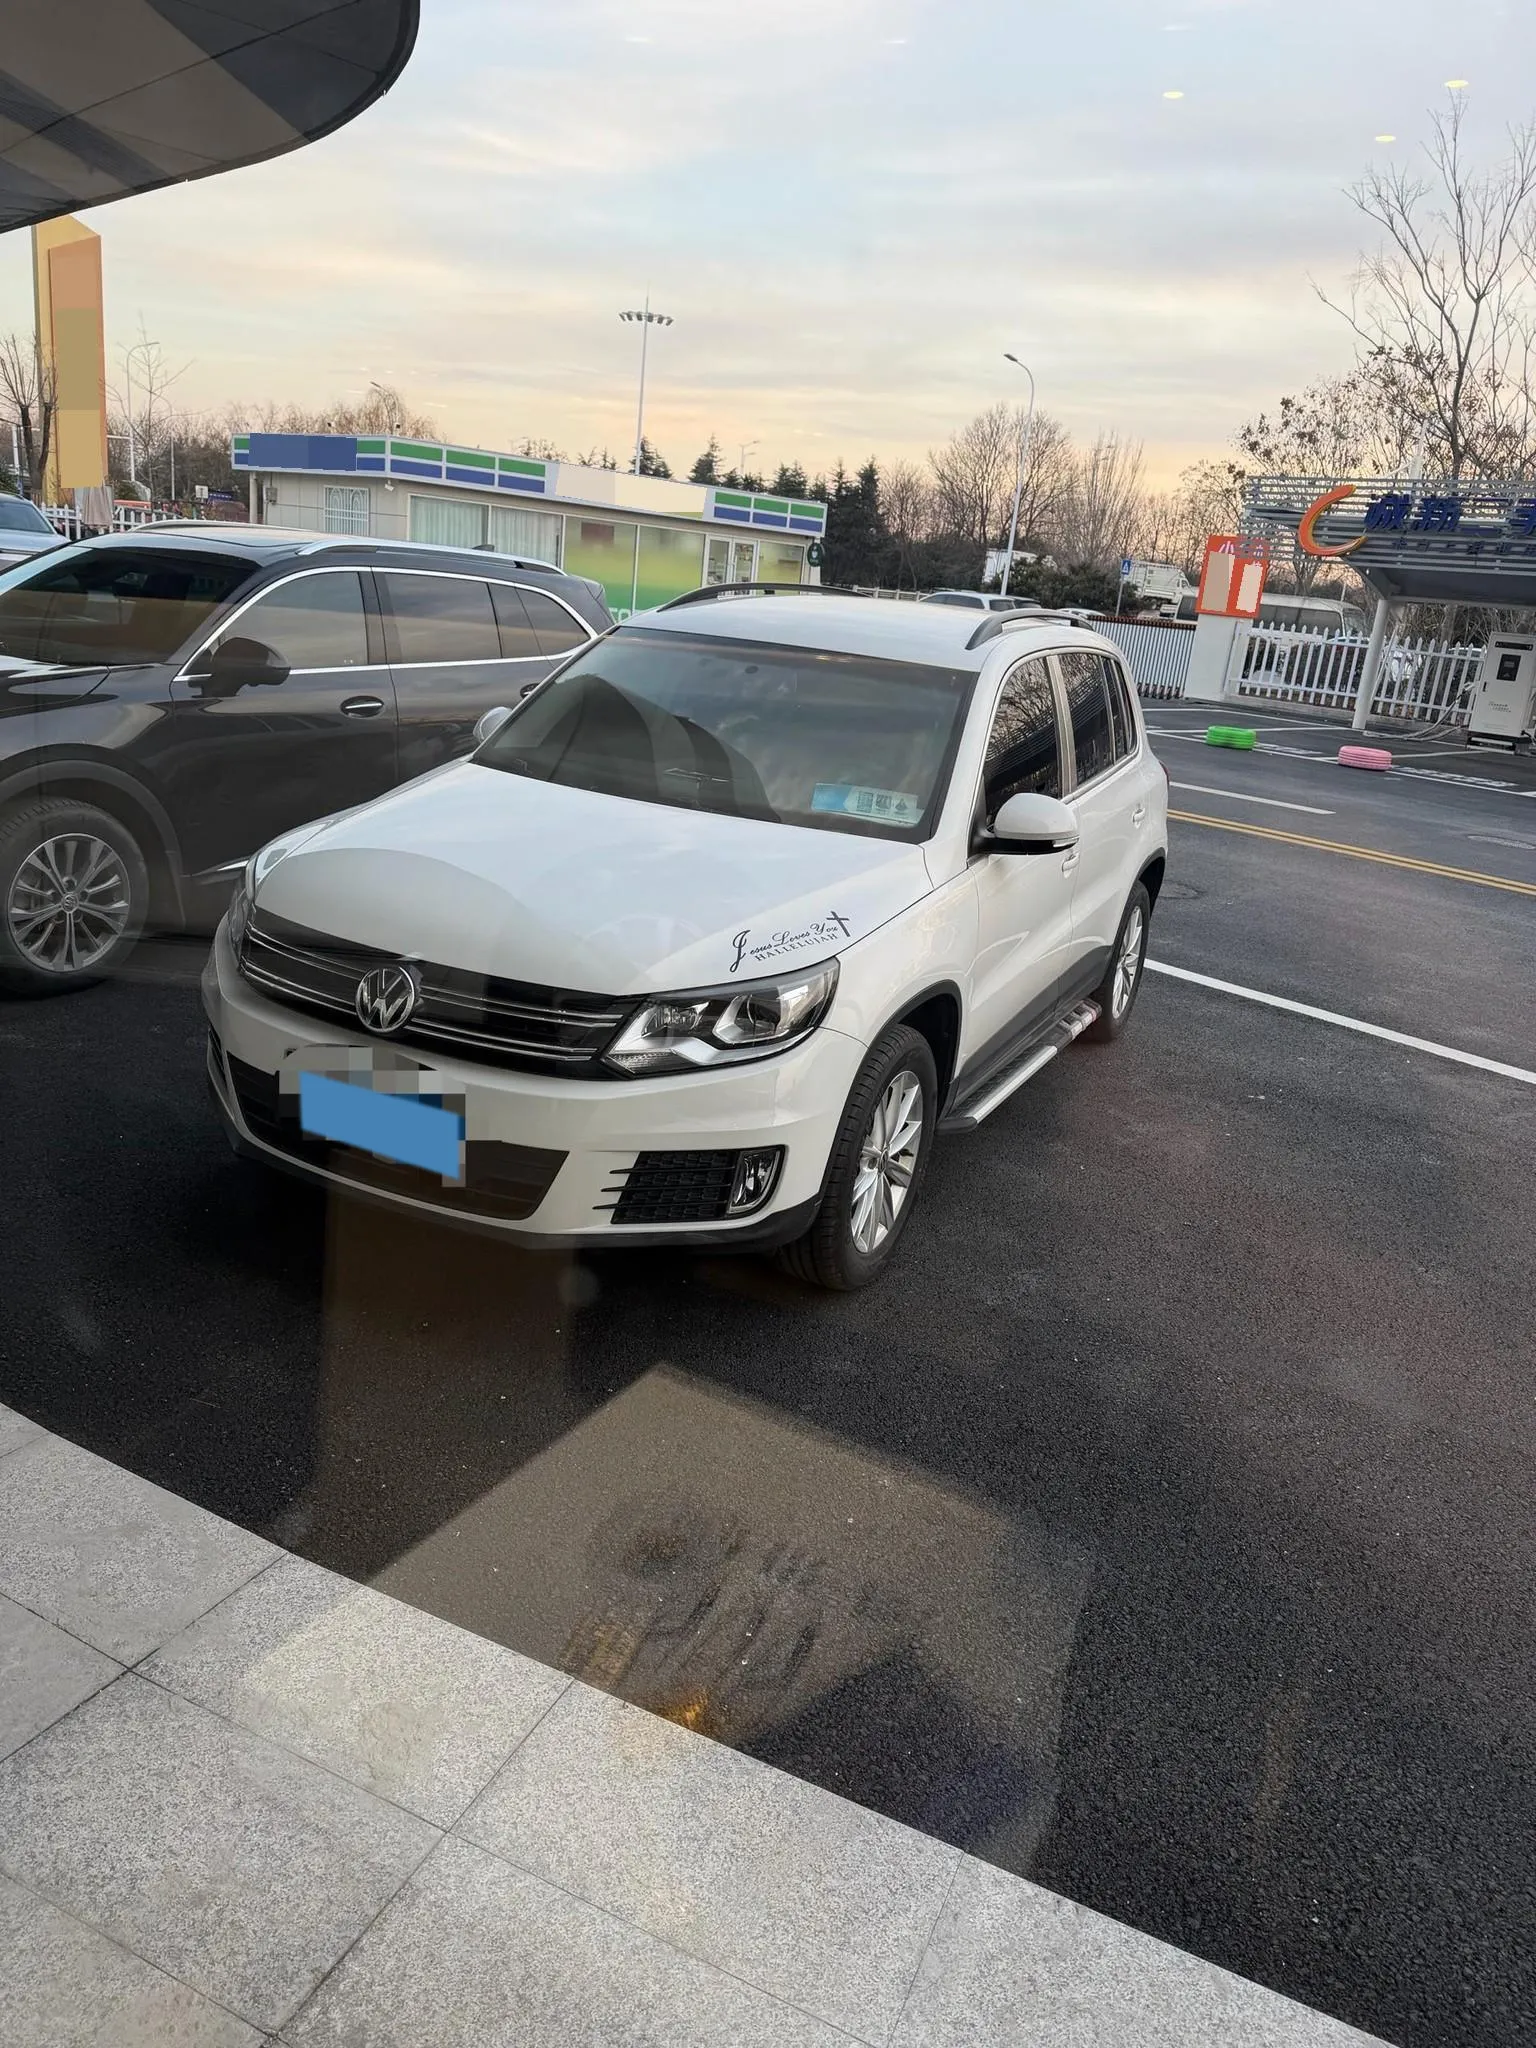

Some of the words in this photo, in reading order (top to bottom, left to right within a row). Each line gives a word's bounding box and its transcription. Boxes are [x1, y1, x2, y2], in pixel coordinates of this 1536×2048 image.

[729, 929, 773, 973] Jesus
[772, 930, 811, 948] Loves
[809, 922, 839, 936] You
